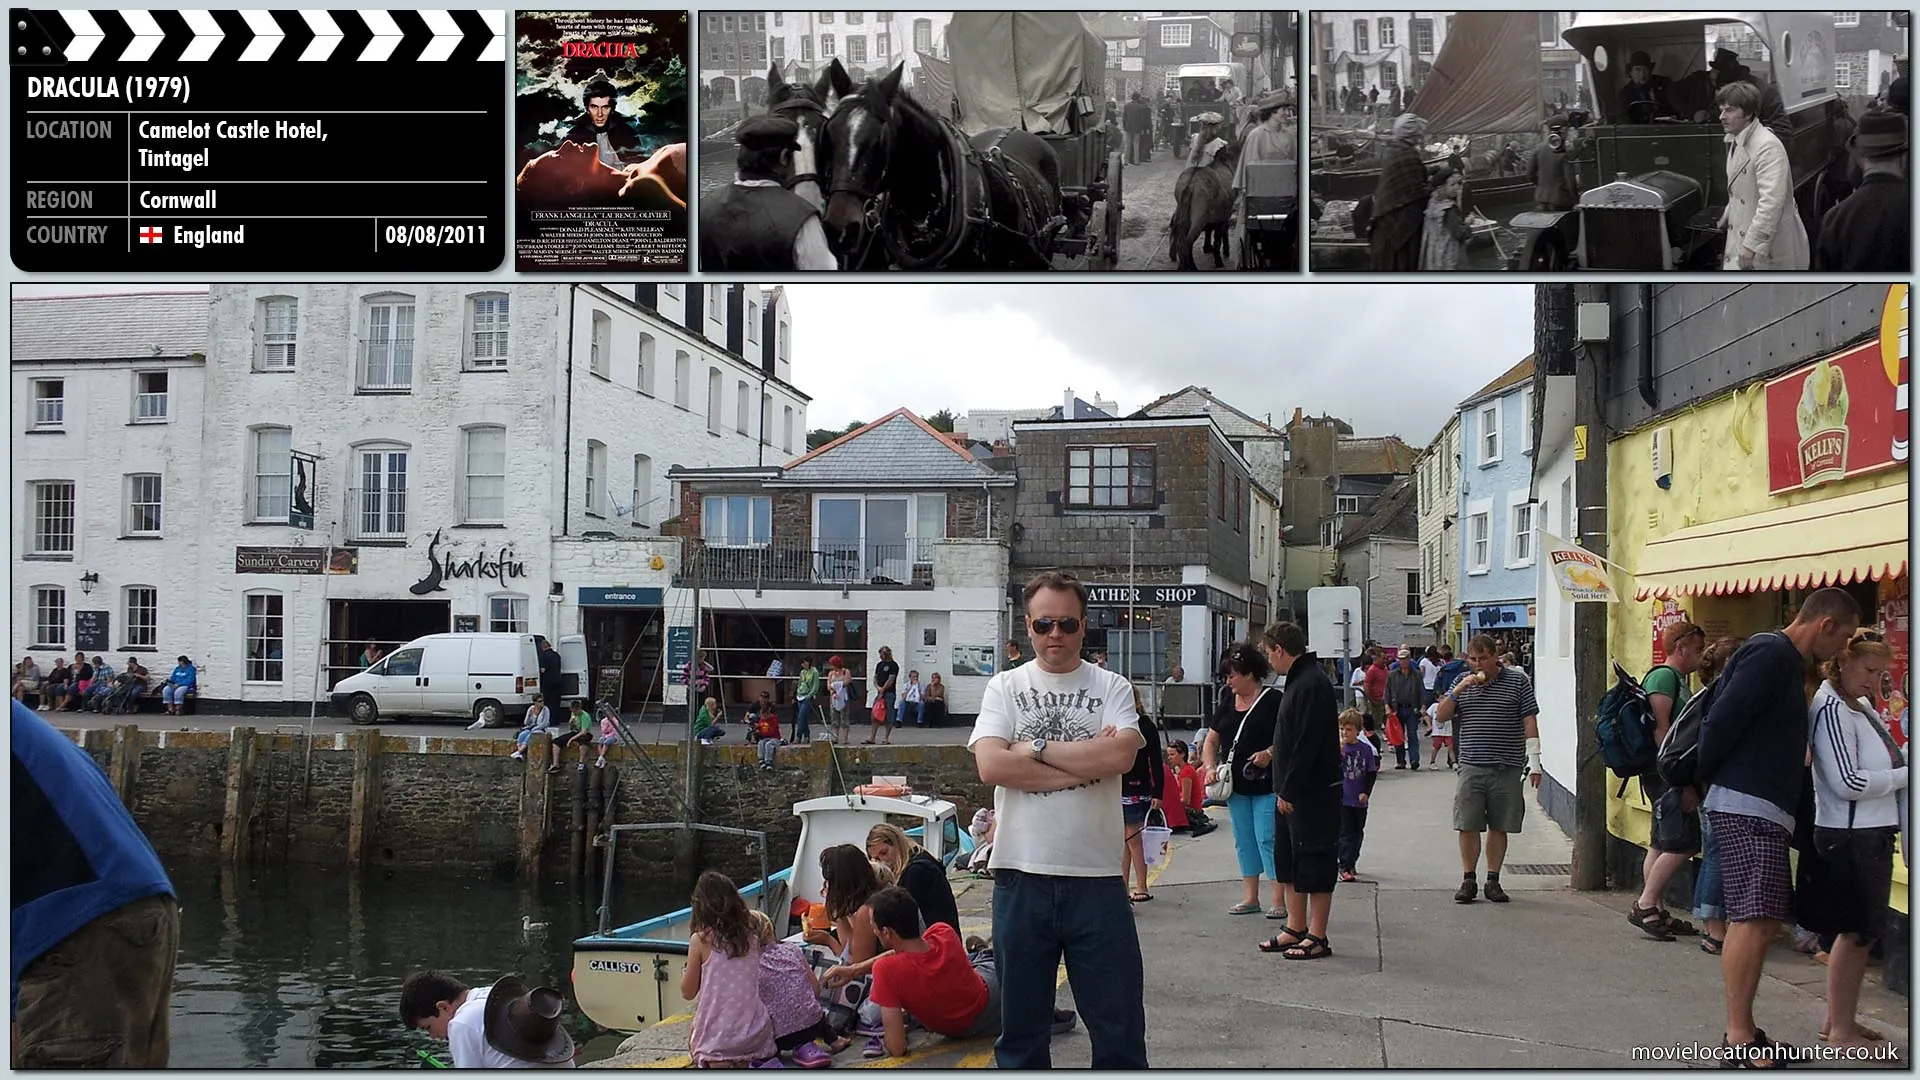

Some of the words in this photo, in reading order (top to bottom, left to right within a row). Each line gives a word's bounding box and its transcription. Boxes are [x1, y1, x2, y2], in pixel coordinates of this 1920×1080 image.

[561, 41, 640, 58] DRACULA
[1804, 438, 1842, 466] KELLY'S
[237, 555, 276, 570] Sunday
[278, 555, 322, 570] Carvery
[1553, 552, 1596, 566] KELLY'S
[1087, 588, 1141, 601] ATHER
[1155, 588, 1197, 601] SHOP
[1015, 687, 1103, 714] Route
[590, 960, 640, 973] CALLISTO
